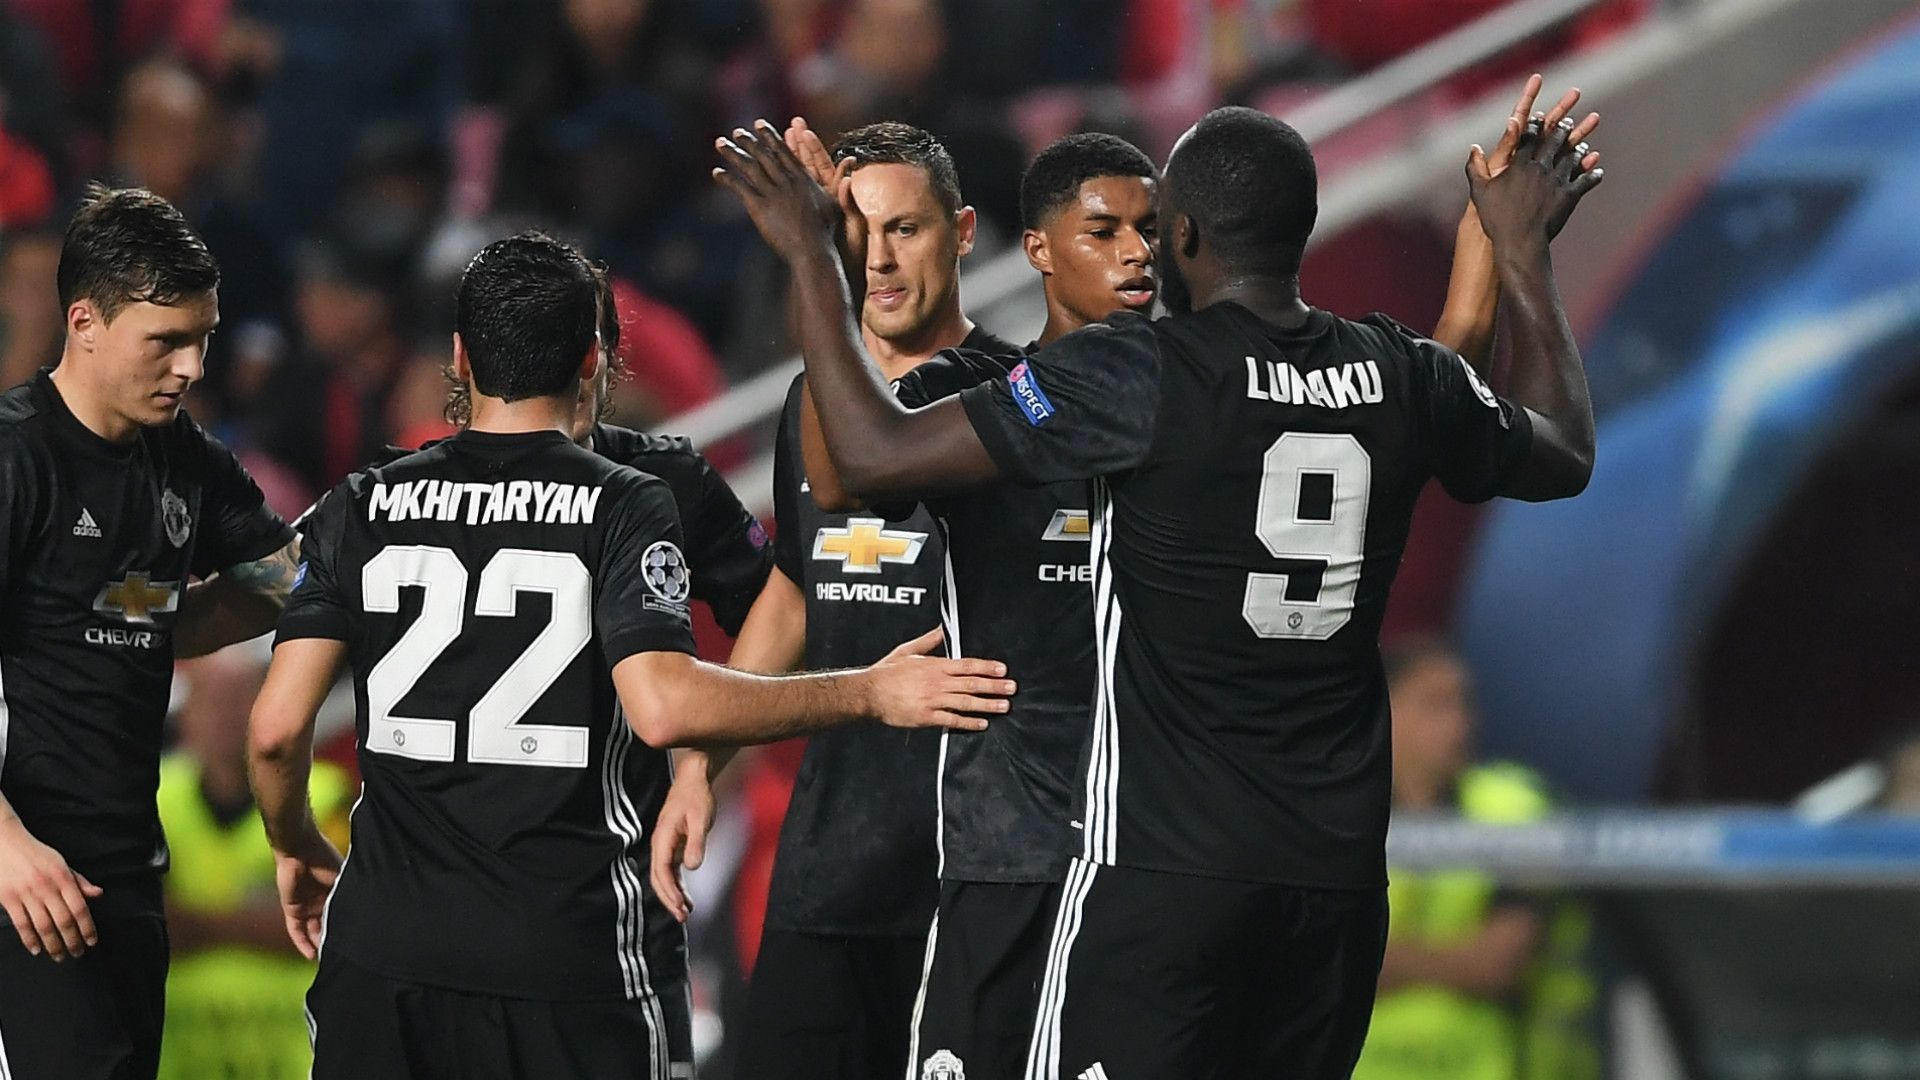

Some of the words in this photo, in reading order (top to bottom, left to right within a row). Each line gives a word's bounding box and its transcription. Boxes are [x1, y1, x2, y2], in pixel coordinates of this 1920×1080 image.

[368, 479, 602, 525] MKHITARYAN
[1242, 432, 1371, 640] 9
[816, 582, 927, 605] CHEVROLET
[85, 627, 158, 649] CHEVR
[362, 545, 593, 768] 22
